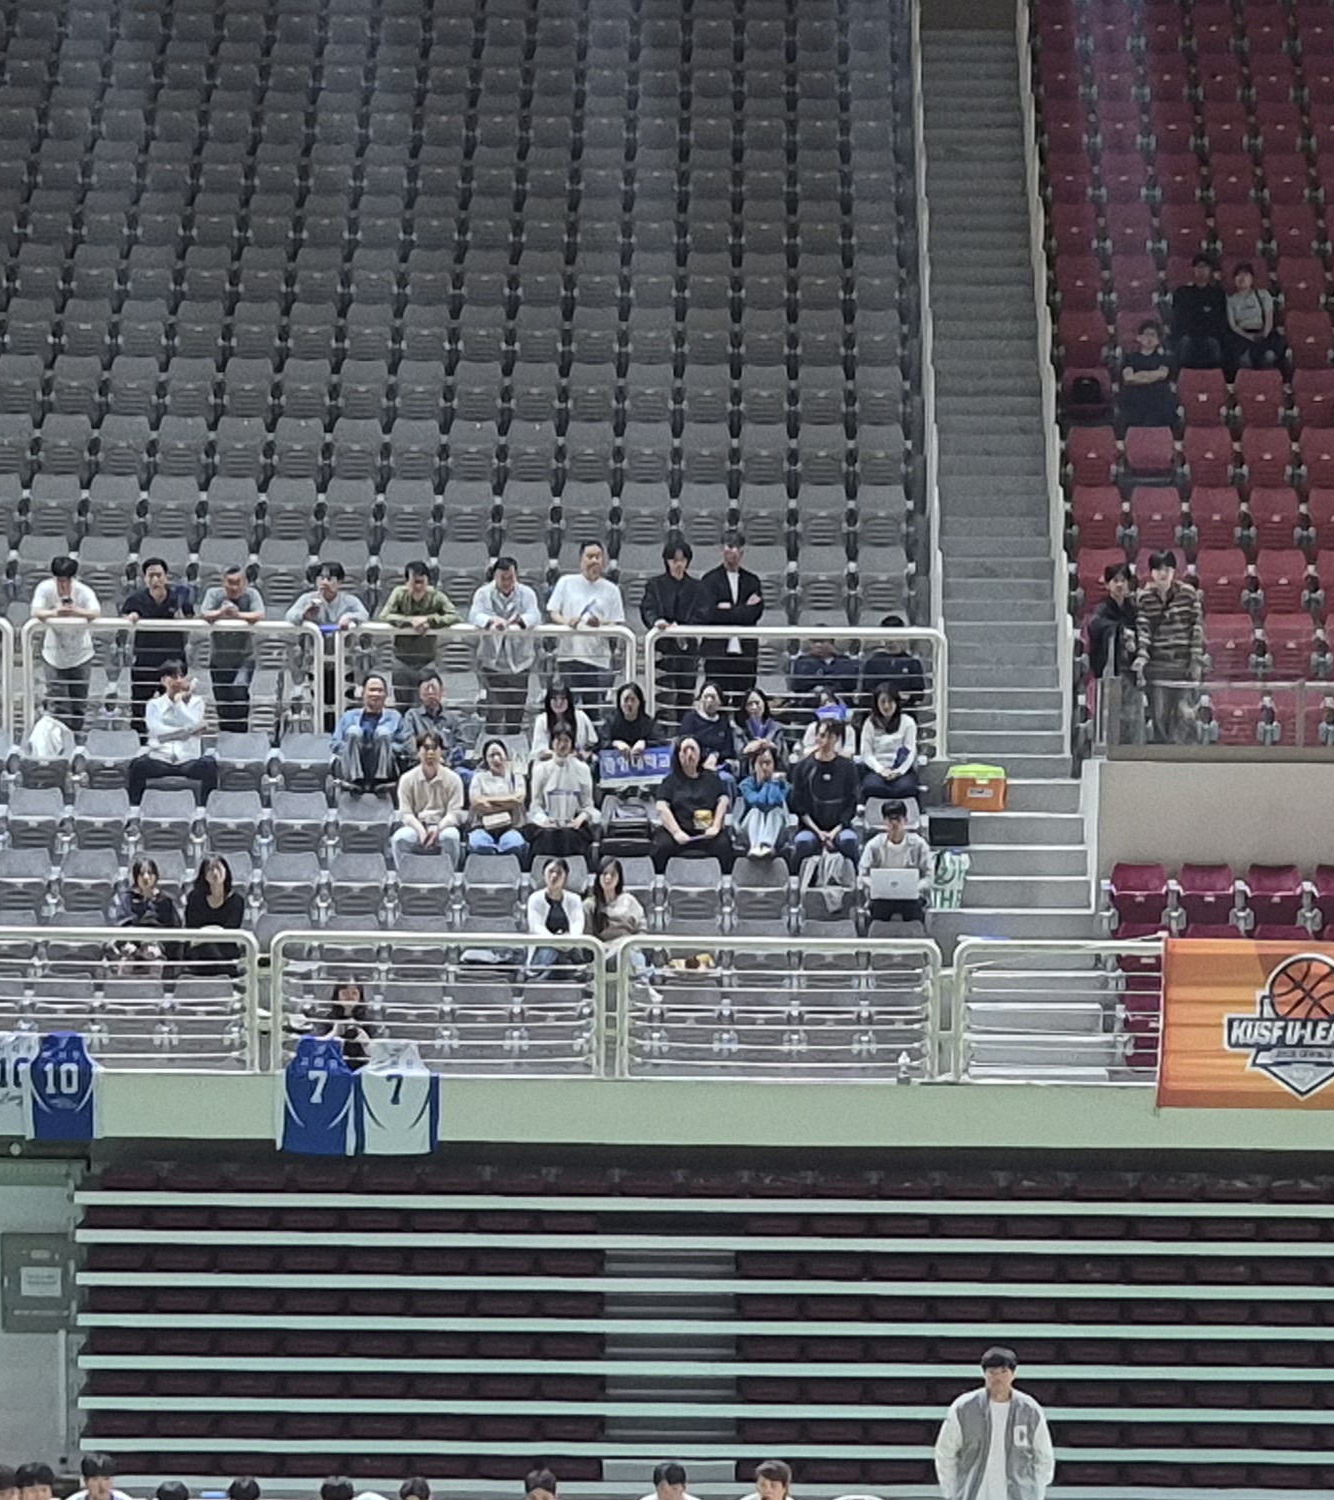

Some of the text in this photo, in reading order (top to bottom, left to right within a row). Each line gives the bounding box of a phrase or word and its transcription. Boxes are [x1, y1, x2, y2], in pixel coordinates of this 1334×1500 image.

[1230, 1019, 1285, 1046] KUSF
[43, 1062, 79, 1094] 10
[307, 1070, 328, 1104] 7
[385, 1074, 404, 1105] 7
